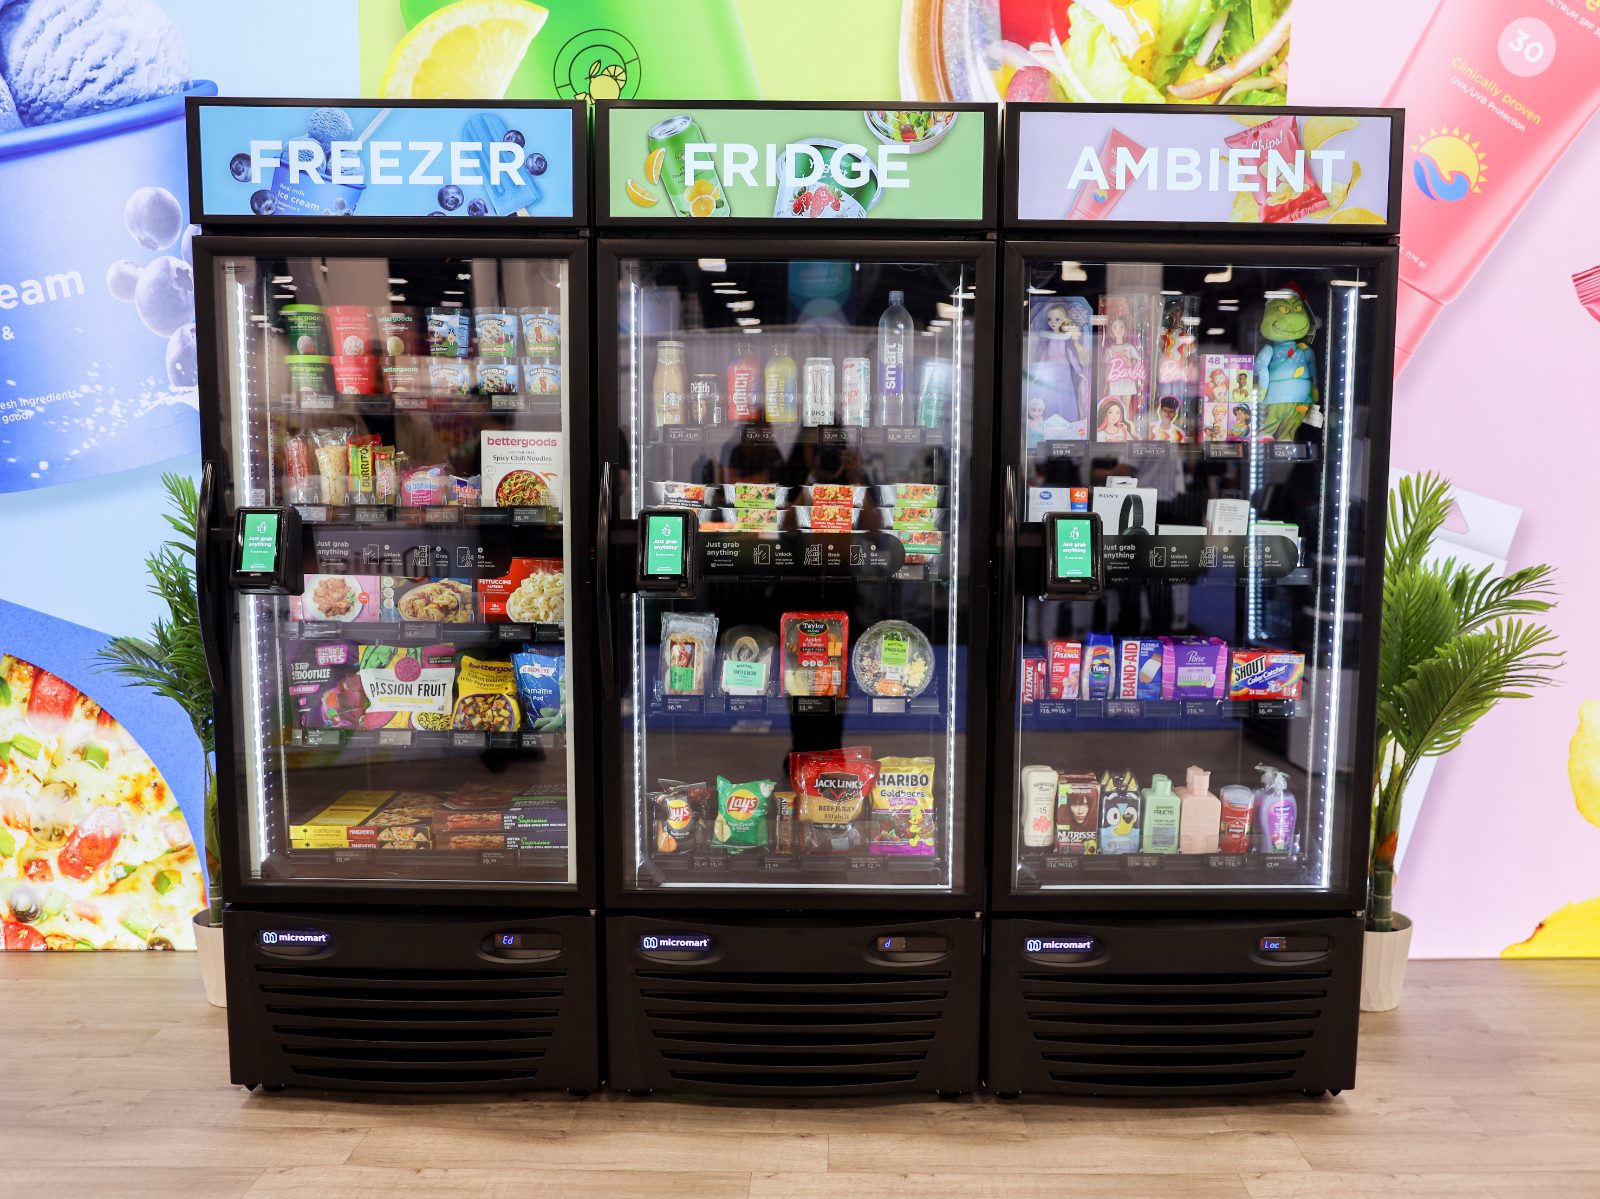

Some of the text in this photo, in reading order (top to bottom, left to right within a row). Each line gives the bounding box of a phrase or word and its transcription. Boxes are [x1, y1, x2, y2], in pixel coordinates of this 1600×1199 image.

[1508, 29, 1545, 63] 30
[1451, 56, 1541, 125] Clinically proven
[1451, 76, 1526, 132] UVA/UVB Protection
[249, 140, 527, 186] FREEZER
[684, 143, 910, 188] FRIDGE
[1066, 146, 1346, 193] AMBIENT
[291, 196, 320, 211] cream
[2, 326, 15, 341] &
[885, 342, 897, 390] smart
[1207, 356, 1221, 365] 48
[690, 381, 710, 393] Death
[487, 436, 557, 448] bettergoods
[510, 454, 526, 462] Chili
[333, 541, 349, 549] grab
[722, 541, 740, 549] grab
[1118, 544, 1136, 552] grab
[317, 548, 348, 556] anything
[706, 549, 739, 557] anything
[802, 622, 825, 630] Taylor
[1186, 650, 1206, 663] Poise
[1234, 656, 1266, 682] SHOUT
[369, 680, 448, 698] PASSION FRUIT
[1024, 665, 1034, 703] TYLENOL
[814, 778, 864, 789] JACK LINK'S
[876, 774, 930, 787] HARIBO
[880, 789, 925, 797] Goldbears
[1057, 831, 1097, 839] NUTRISSE
[278, 932, 327, 942] micromart
[659, 938, 708, 947] micromart
[1042, 940, 1092, 949] micromart
[1264, 940, 1280, 949] Loc
